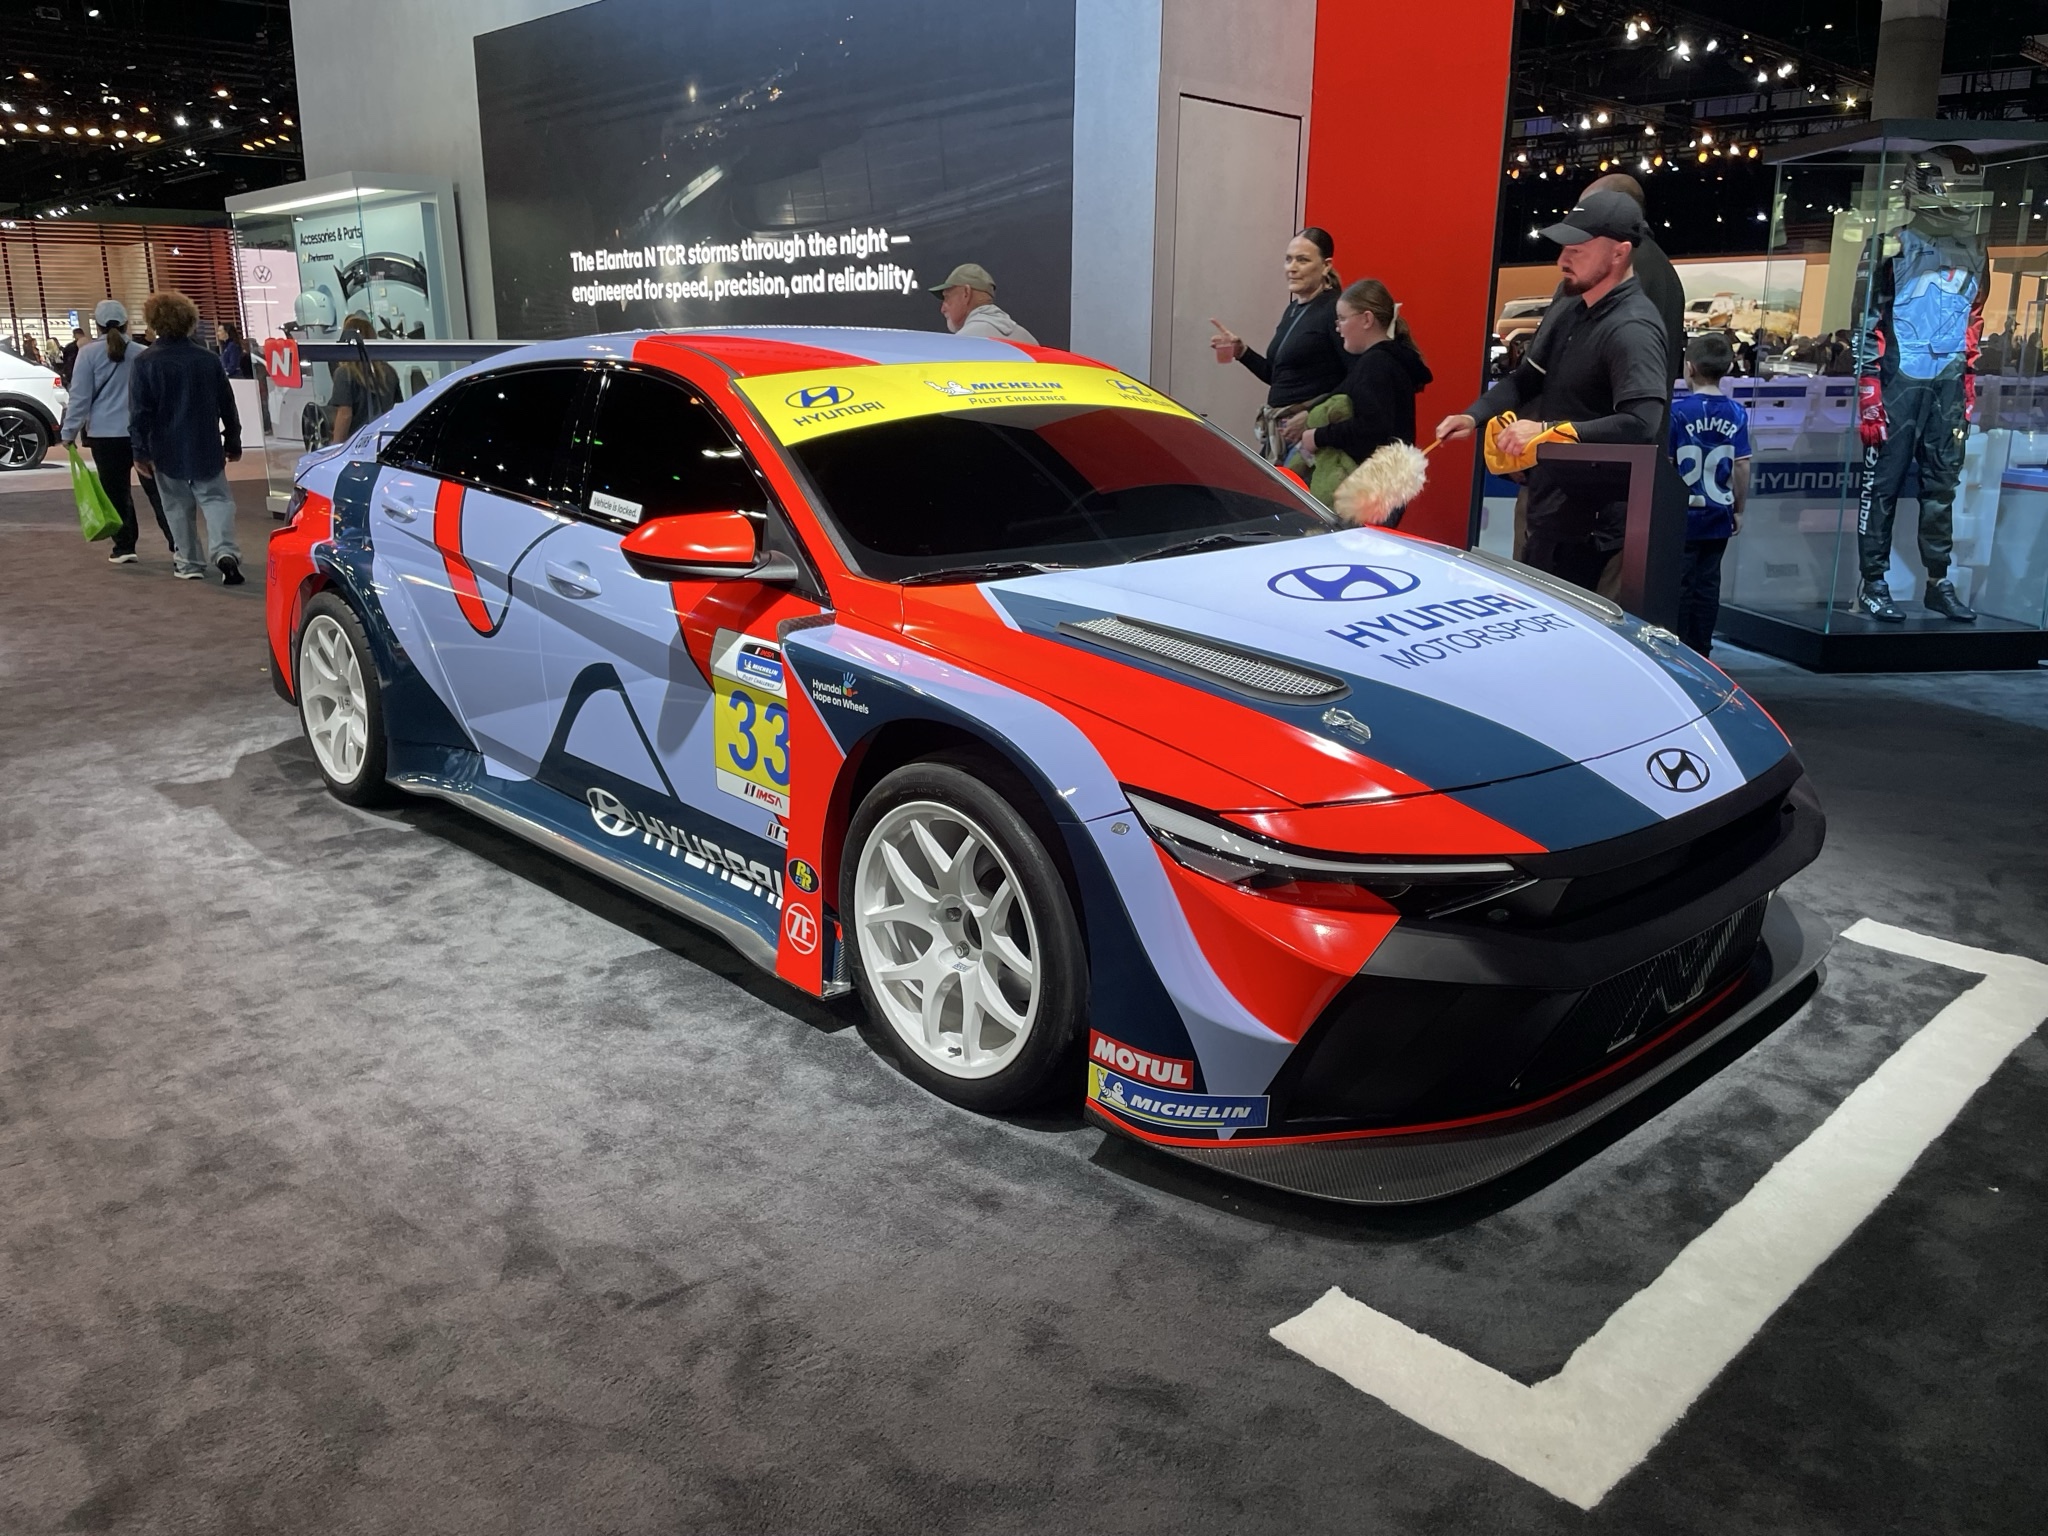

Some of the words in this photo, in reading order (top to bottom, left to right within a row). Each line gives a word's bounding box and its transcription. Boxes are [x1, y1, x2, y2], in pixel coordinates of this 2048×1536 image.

[300, 228, 337, 246] Accessories
[337, 227, 343, 241] &
[343, 226, 363, 241] Parts
[570, 251, 595, 272] The
[596, 250, 643, 271] Elantra
[645, 246, 657, 268] N
[657, 244, 687, 267] TCR
[687, 241, 740, 265] storms
[741, 234, 804, 263] through
[808, 232, 837, 257] the
[839, 228, 888, 259] night
[571, 279, 643, 306] engineered
[643, 278, 665, 300] for
[665, 276, 713, 303] speed,
[714, 271, 790, 302] precision,
[790, 269, 826, 294] and
[827, 263, 918, 295] reliability.
[271, 347, 292, 377] N
[970, 381, 1064, 391] MICHELIN
[967, 396, 1002, 405] PILOT
[1005, 394, 1068, 403] CHALLENGE
[792, 400, 886, 427] HYUNDAI
[1685, 417, 1739, 439] PALMER
[1676, 444, 1735, 507] 20
[1751, 471, 1860, 490] HYUNDAI
[594, 496, 613, 510] Vehicle
[612, 501, 618, 511] is
[617, 503, 637, 518] locked.
[1858, 471, 1875, 536] HYUNDAI
[1324, 592, 1538, 649] HYUNDAI
[1379, 613, 1577, 669] MOTORSPORT
[752, 663, 779, 676] MICHELIN
[812, 678, 842, 696] Hyundai
[812, 689, 832, 705] Hope
[832, 697, 842, 707] on
[842, 697, 869, 715] Wheels
[727, 689, 791, 787] 33
[755, 788, 783, 809] IMSA
[637, 811, 784, 911] HYUNDAI
[1093, 1037, 1188, 1085] MOTUL
[1130, 1094, 1252, 1119] MICHELIN
